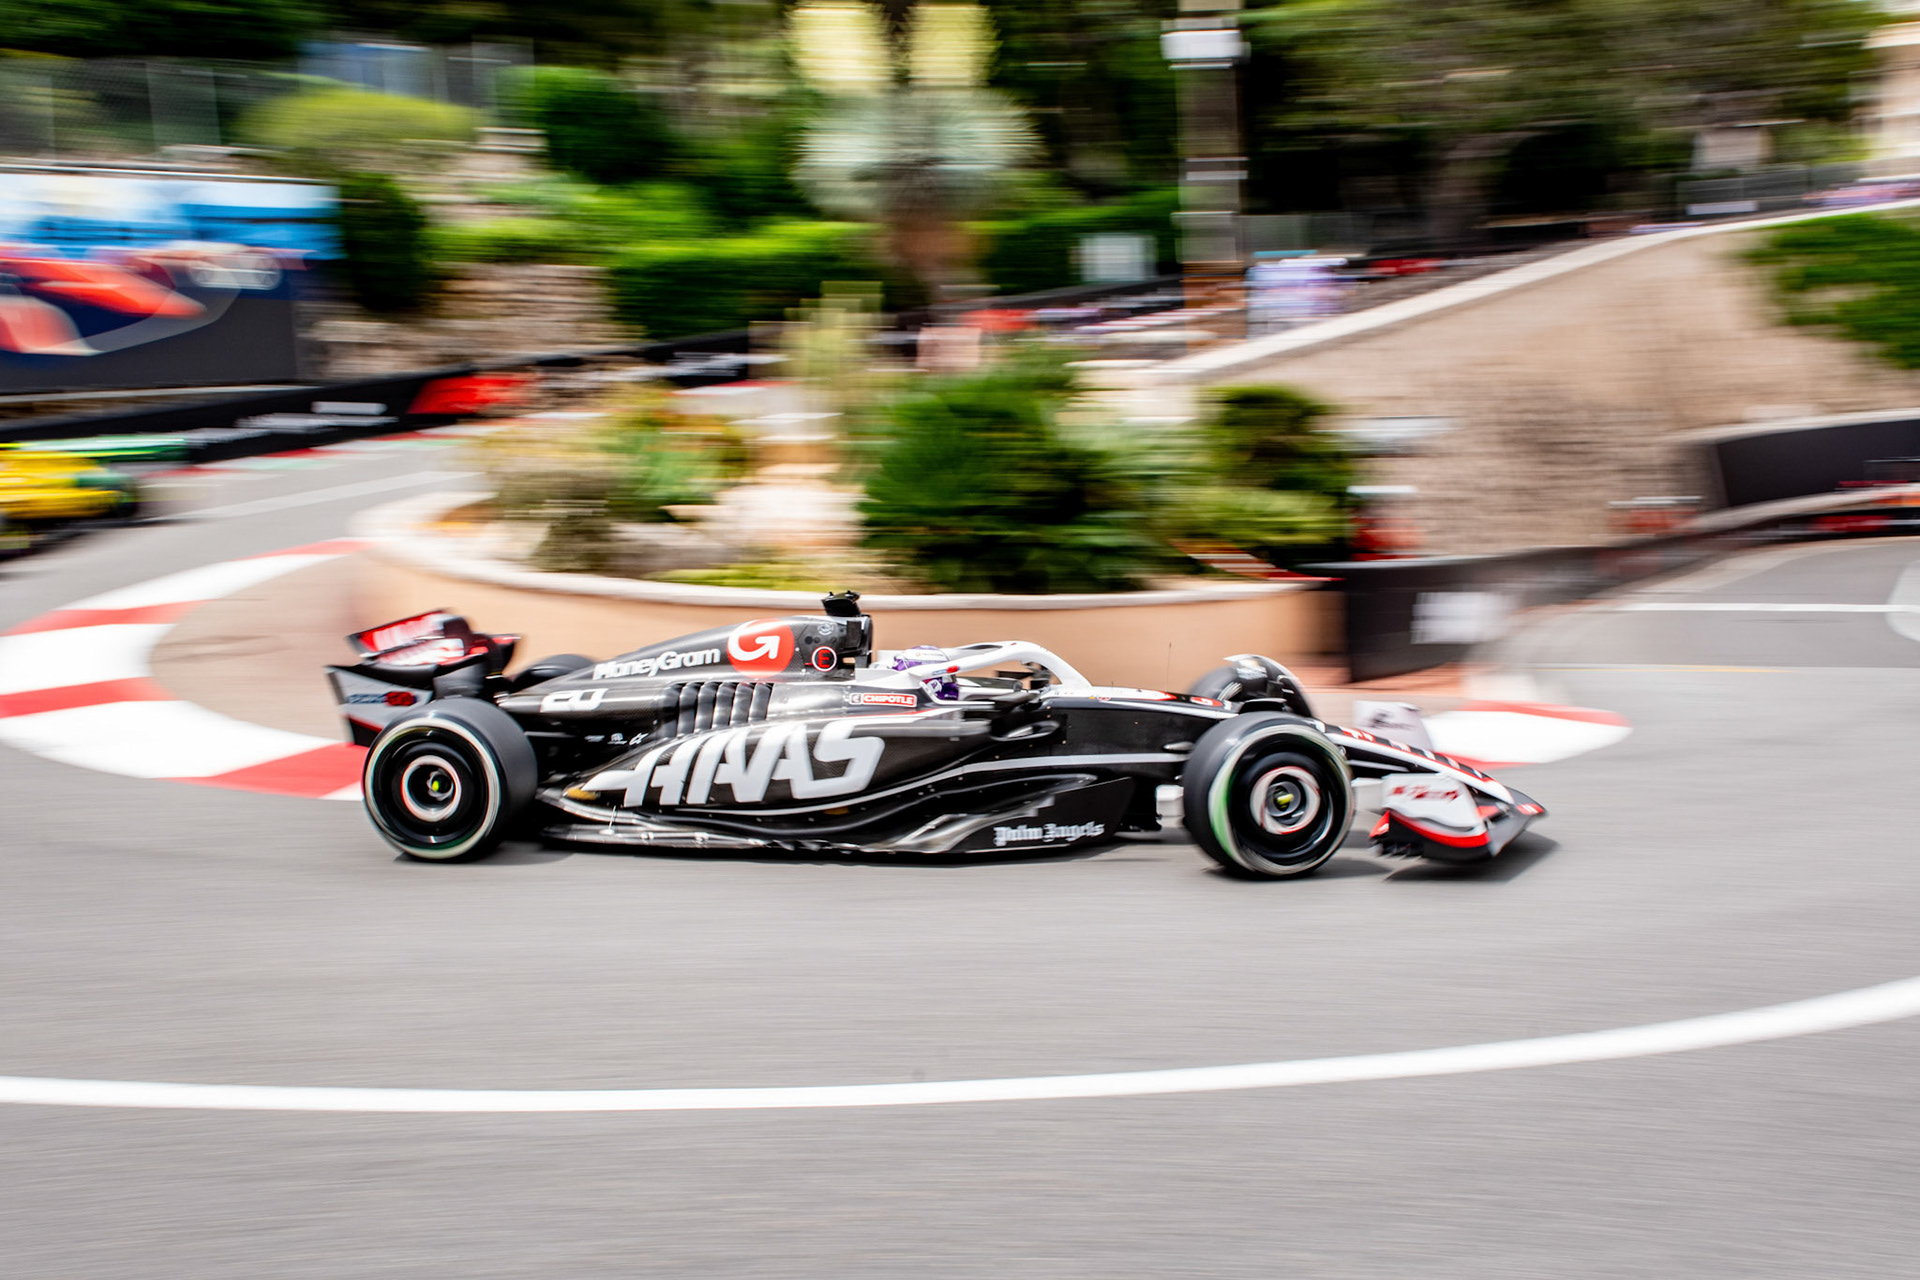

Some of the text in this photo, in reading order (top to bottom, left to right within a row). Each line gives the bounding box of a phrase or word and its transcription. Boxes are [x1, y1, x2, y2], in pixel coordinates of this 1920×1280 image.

[592, 648, 721, 681] MoneyGram
[817, 649, 830, 668] E
[864, 694, 913, 705] CHIPOTLE
[581, 721, 886, 807] HAAS
[993, 821, 1105, 847] Palm Angels
